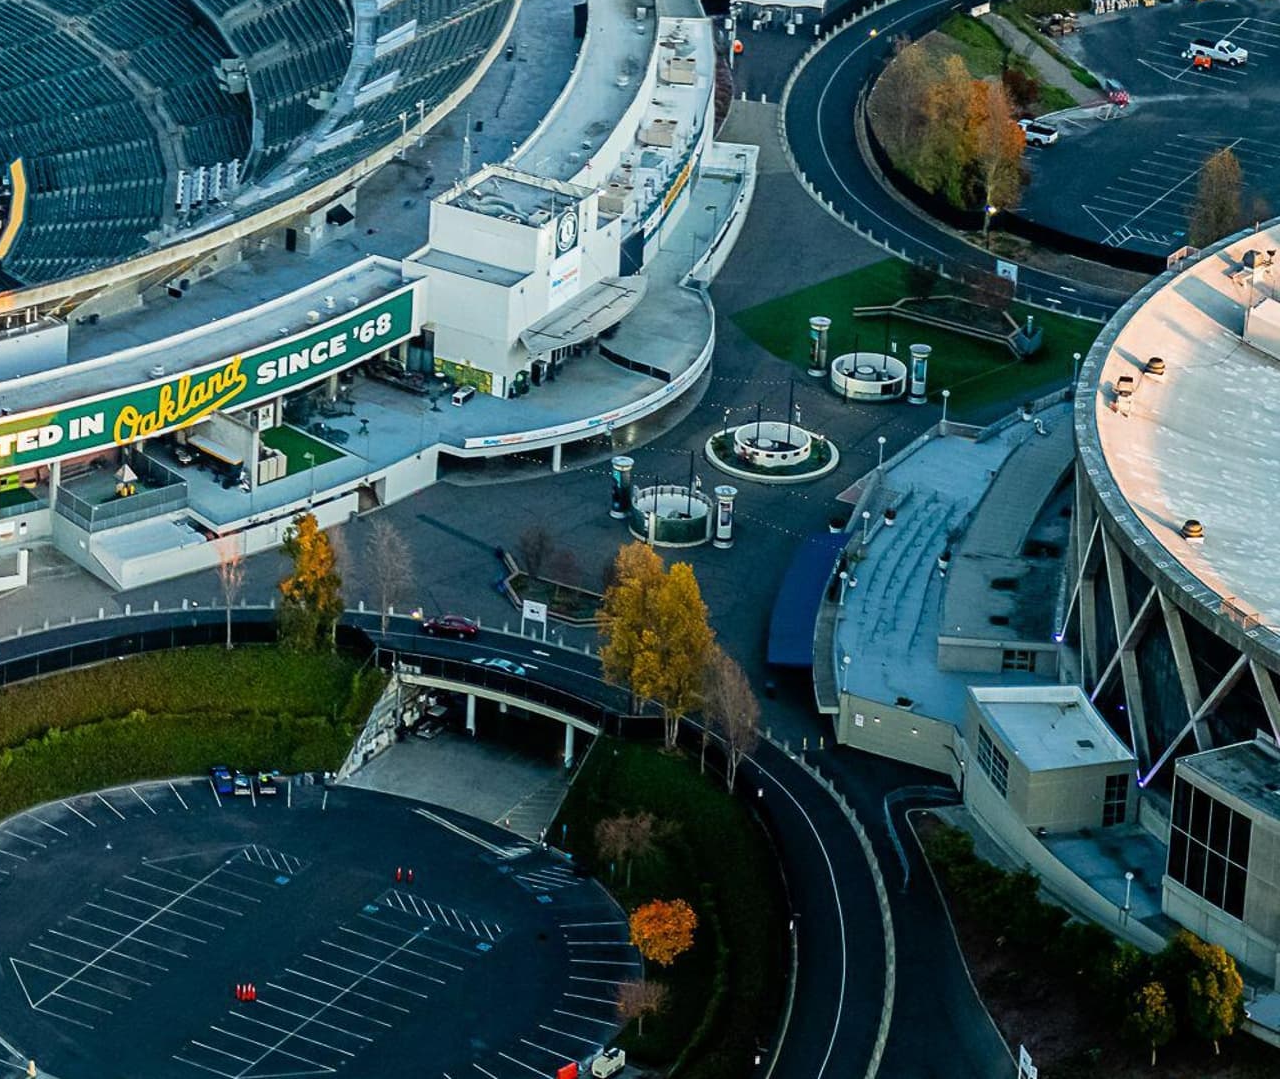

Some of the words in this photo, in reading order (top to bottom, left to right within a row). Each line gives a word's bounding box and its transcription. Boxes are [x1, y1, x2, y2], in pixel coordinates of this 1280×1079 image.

[69, 412, 105, 438] IN
[113, 354, 247, 447] Oakland
[255, 333, 348, 386] SINCE
